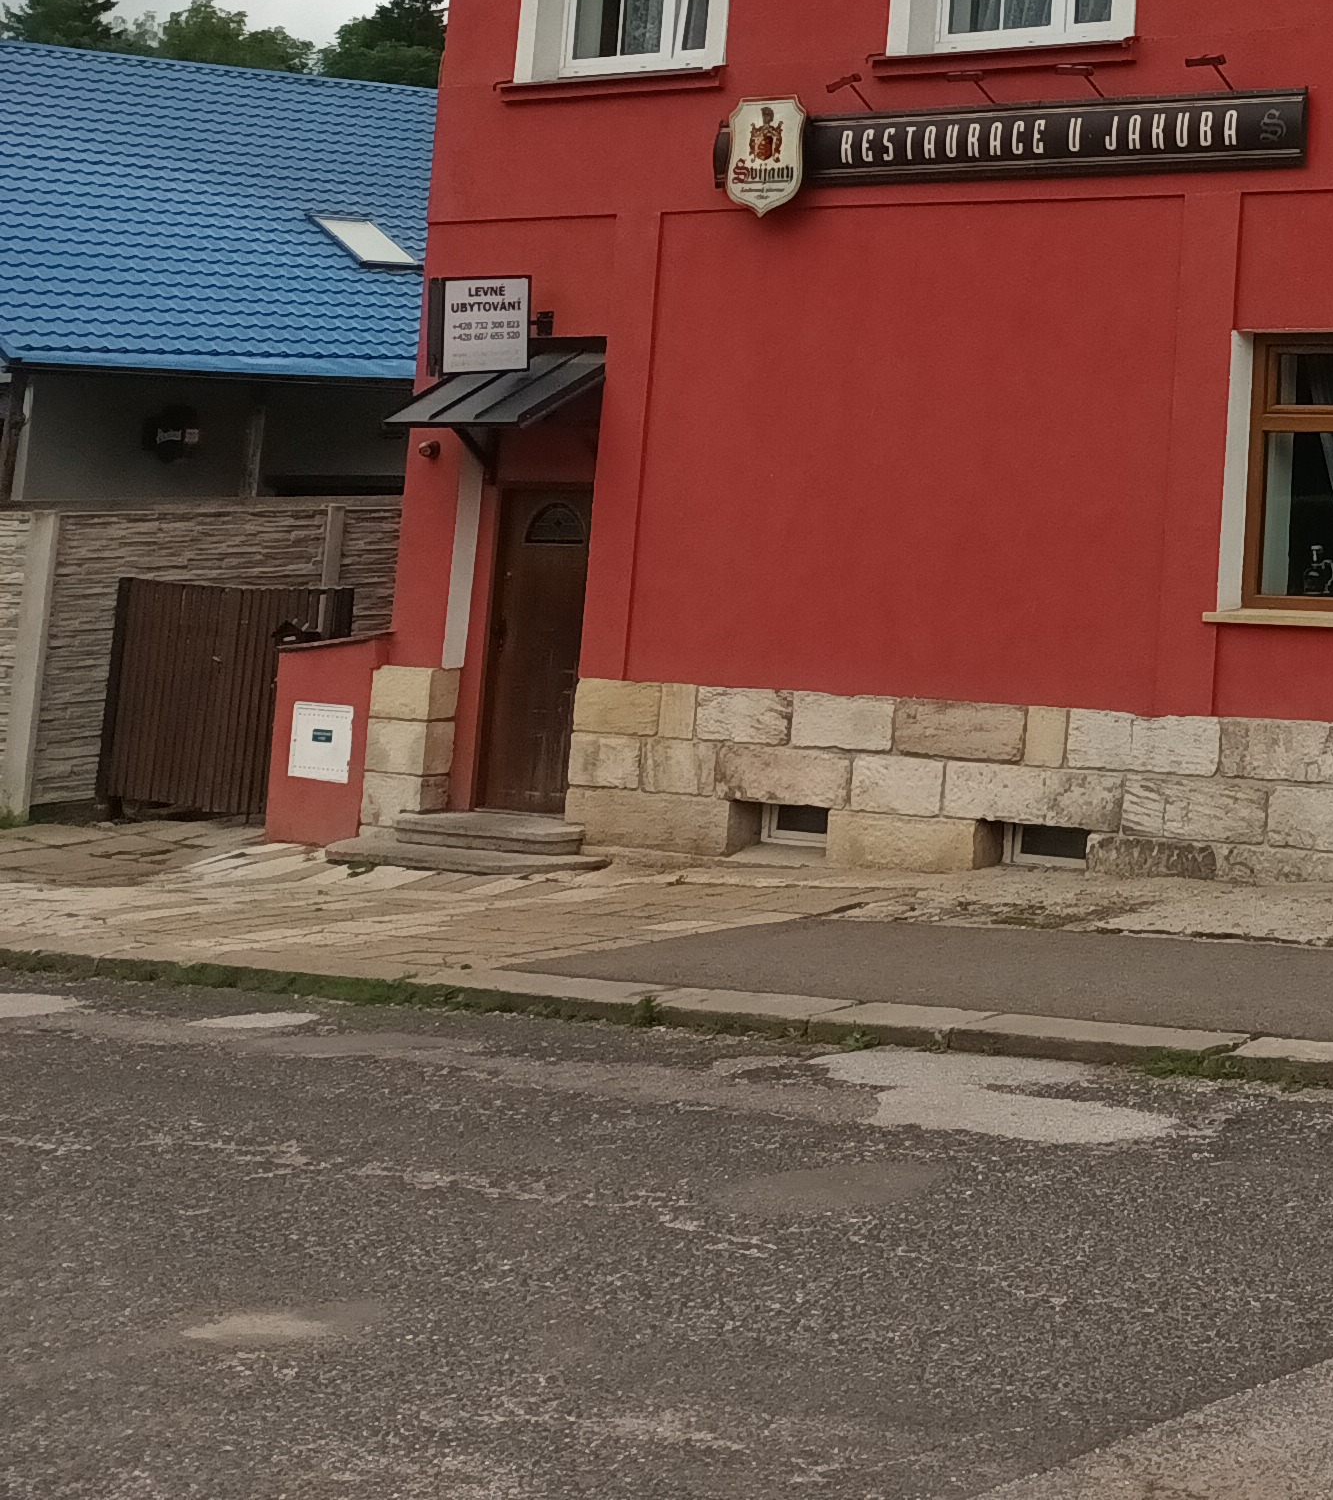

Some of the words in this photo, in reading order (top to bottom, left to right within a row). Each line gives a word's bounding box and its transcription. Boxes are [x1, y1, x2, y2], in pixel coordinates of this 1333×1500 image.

[840, 119, 1046, 164] RESTAURACE
[1068, 117, 1082, 152] U
[1104, 109, 1238, 151] JAKUBA
[731, 158, 794, 185] Svijany
[468, 283, 506, 298] LEVNÉ
[450, 297, 522, 314] UBYTOVÁNÍ
